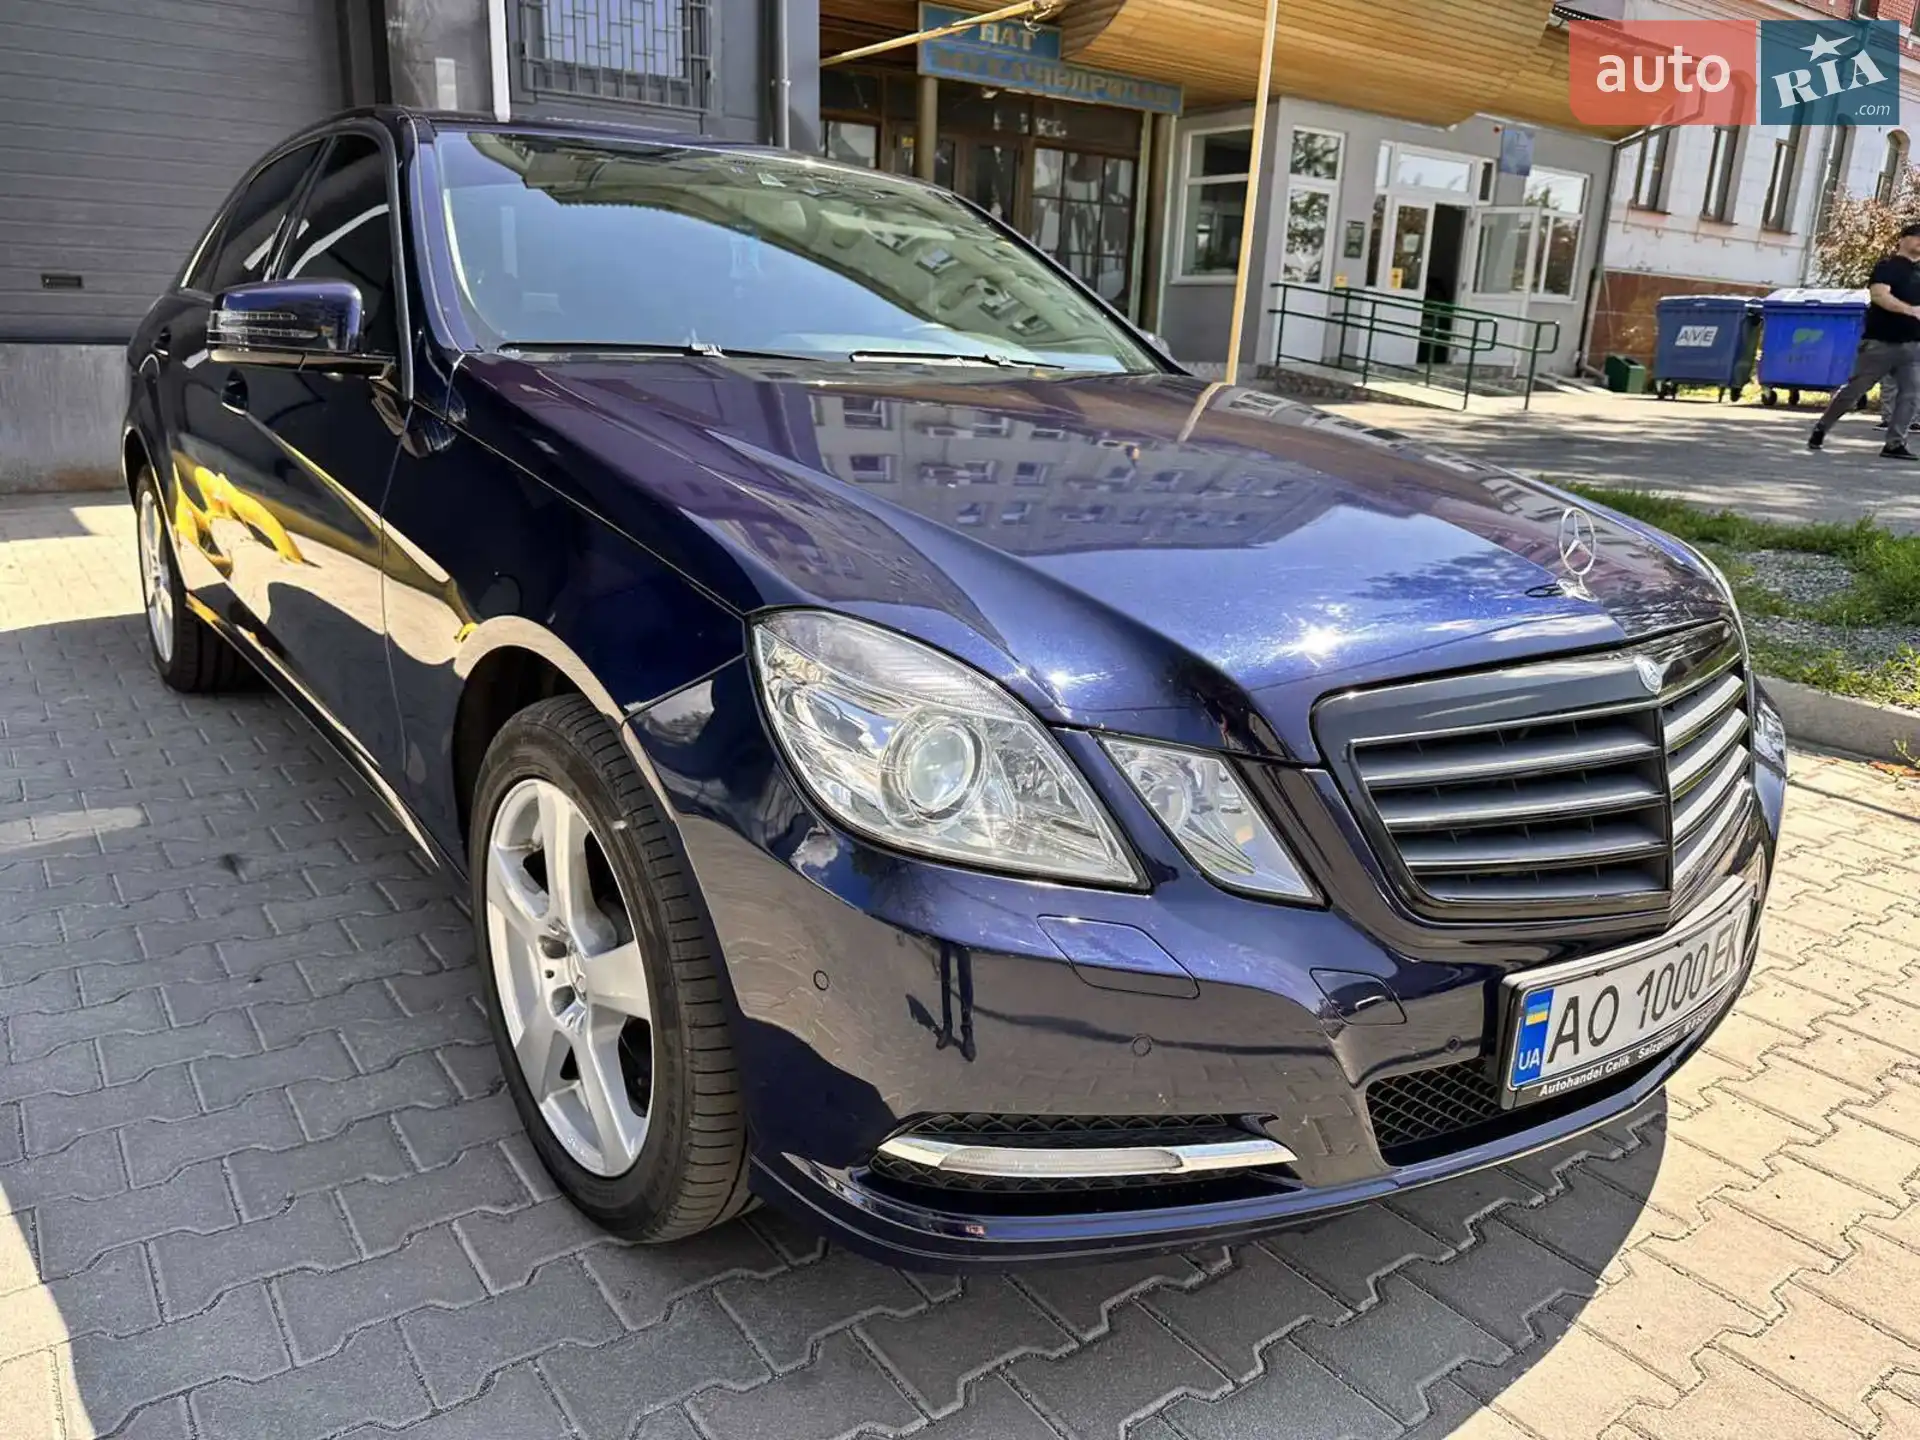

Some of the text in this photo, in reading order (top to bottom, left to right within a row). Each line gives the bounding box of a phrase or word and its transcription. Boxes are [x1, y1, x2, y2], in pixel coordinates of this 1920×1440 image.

[1678, 328, 1713, 343] AVE
[1547, 985, 1619, 1064] AO
[1636, 942, 1709, 1030] 1000
[1518, 1050, 1540, 1071] UA
[1539, 1066, 1603, 1097] Autohandel
[1605, 1055, 1631, 1073] Celik
